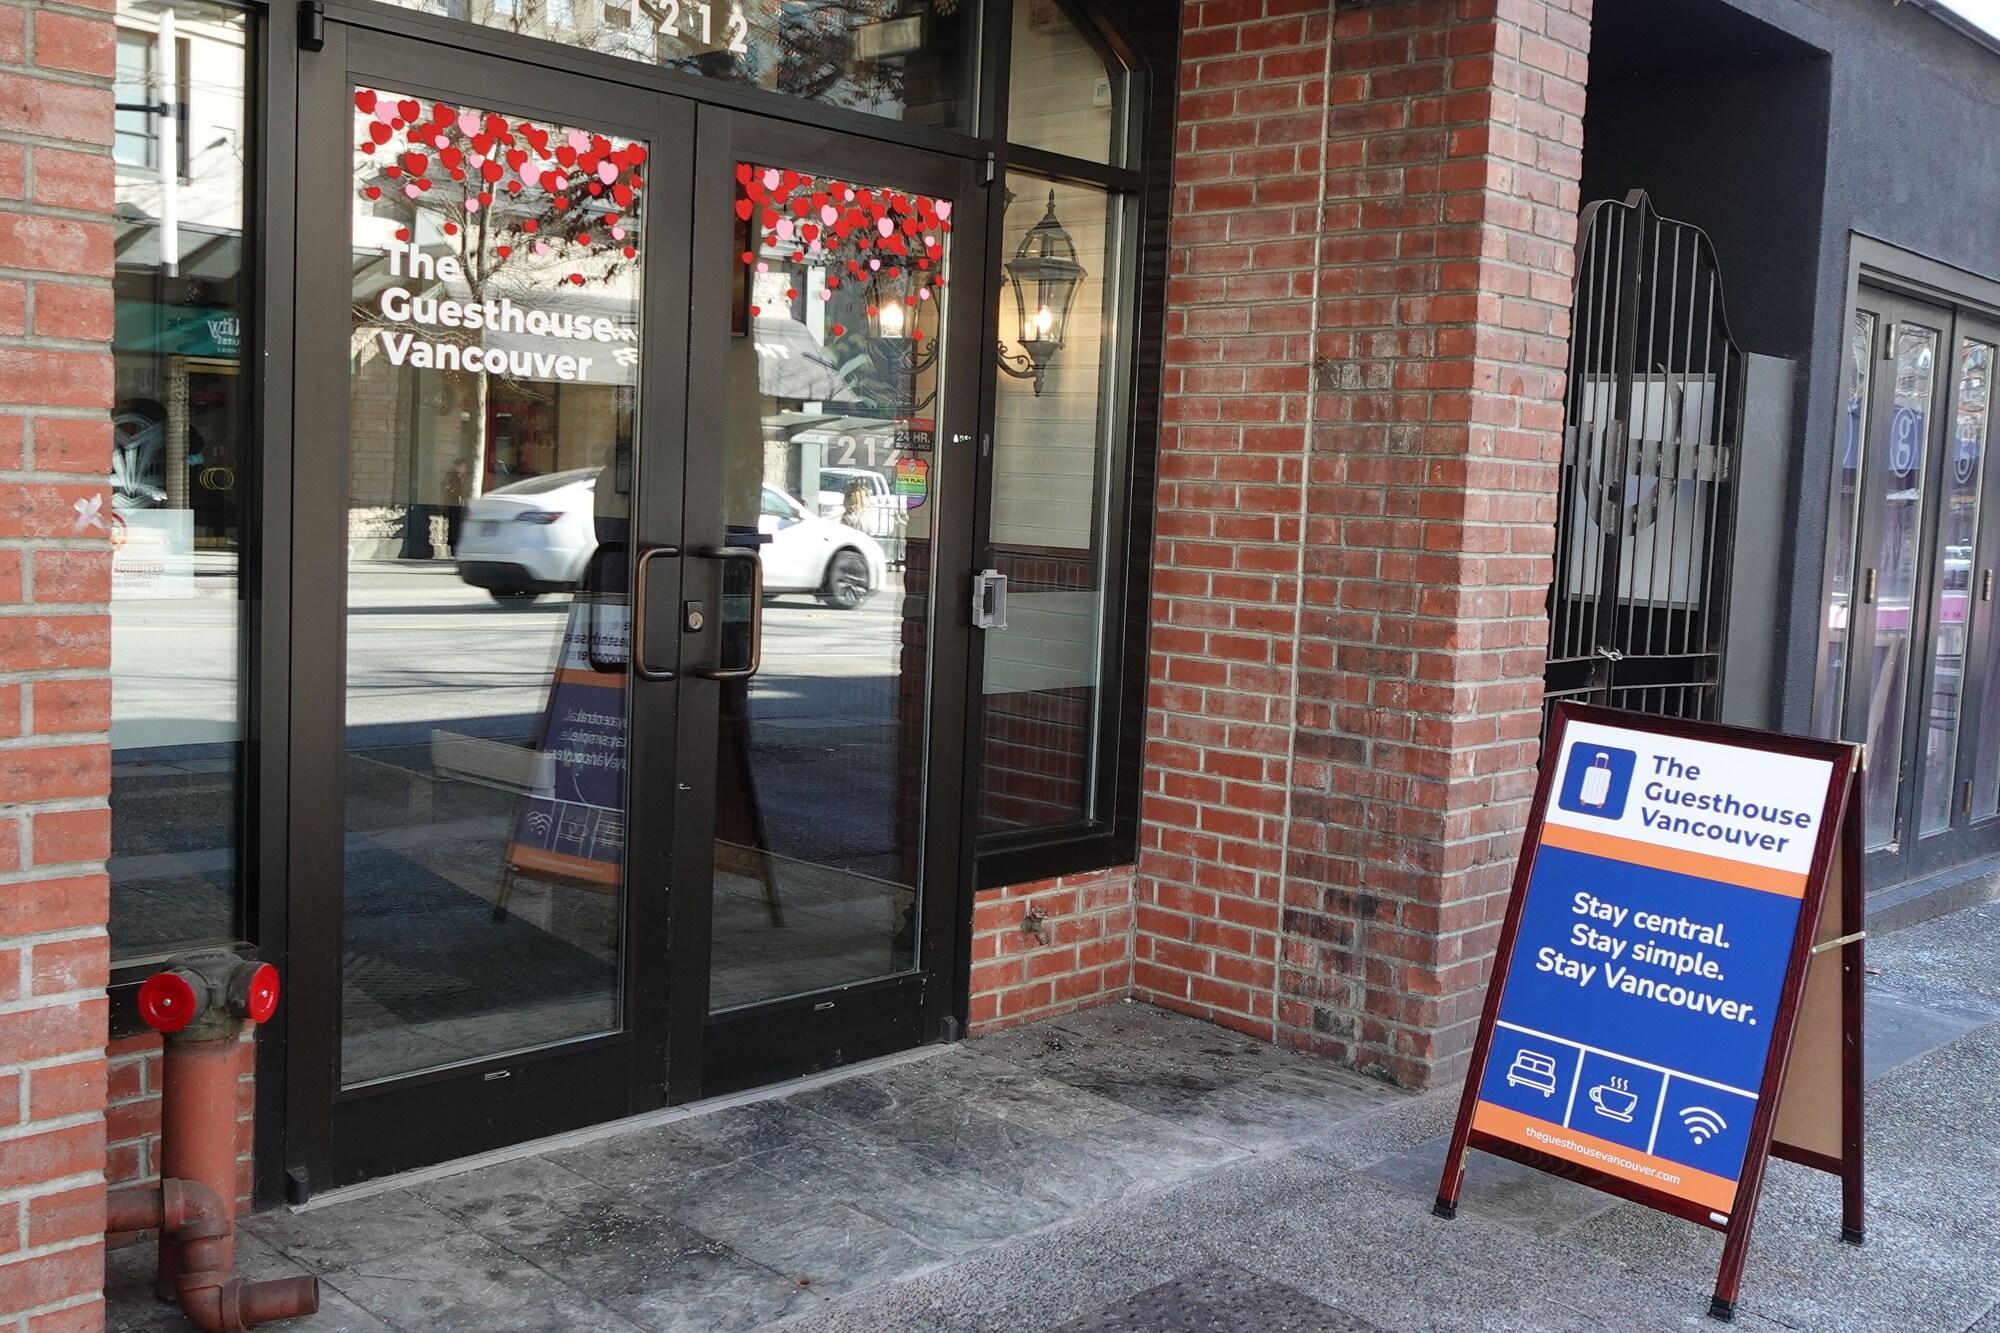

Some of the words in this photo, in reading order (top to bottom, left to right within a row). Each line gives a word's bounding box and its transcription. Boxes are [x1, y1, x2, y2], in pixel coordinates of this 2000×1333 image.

[631, 0, 748, 54] 1212
[383, 243, 460, 282] The
[381, 287, 614, 342] Guesthouse
[380, 331, 593, 381] Vancouver
[896, 431, 909, 442] 24
[913, 432, 930, 443] HR.
[1653, 755, 1700, 780] The
[1641, 807, 1789, 852] Vancouver
[1645, 782, 1811, 829] Guesthouse
[1572, 892, 1628, 928] Stay
[1633, 911, 1730, 948] central.
[1570, 923, 1627, 960] Stay
[1631, 940, 1724, 981] simple.
[1536, 947, 1597, 987] Stay
[1604, 962, 1757, 1026] Vancouver.
[1525, 1126, 1681, 1185] theguesthousevancouver.com
